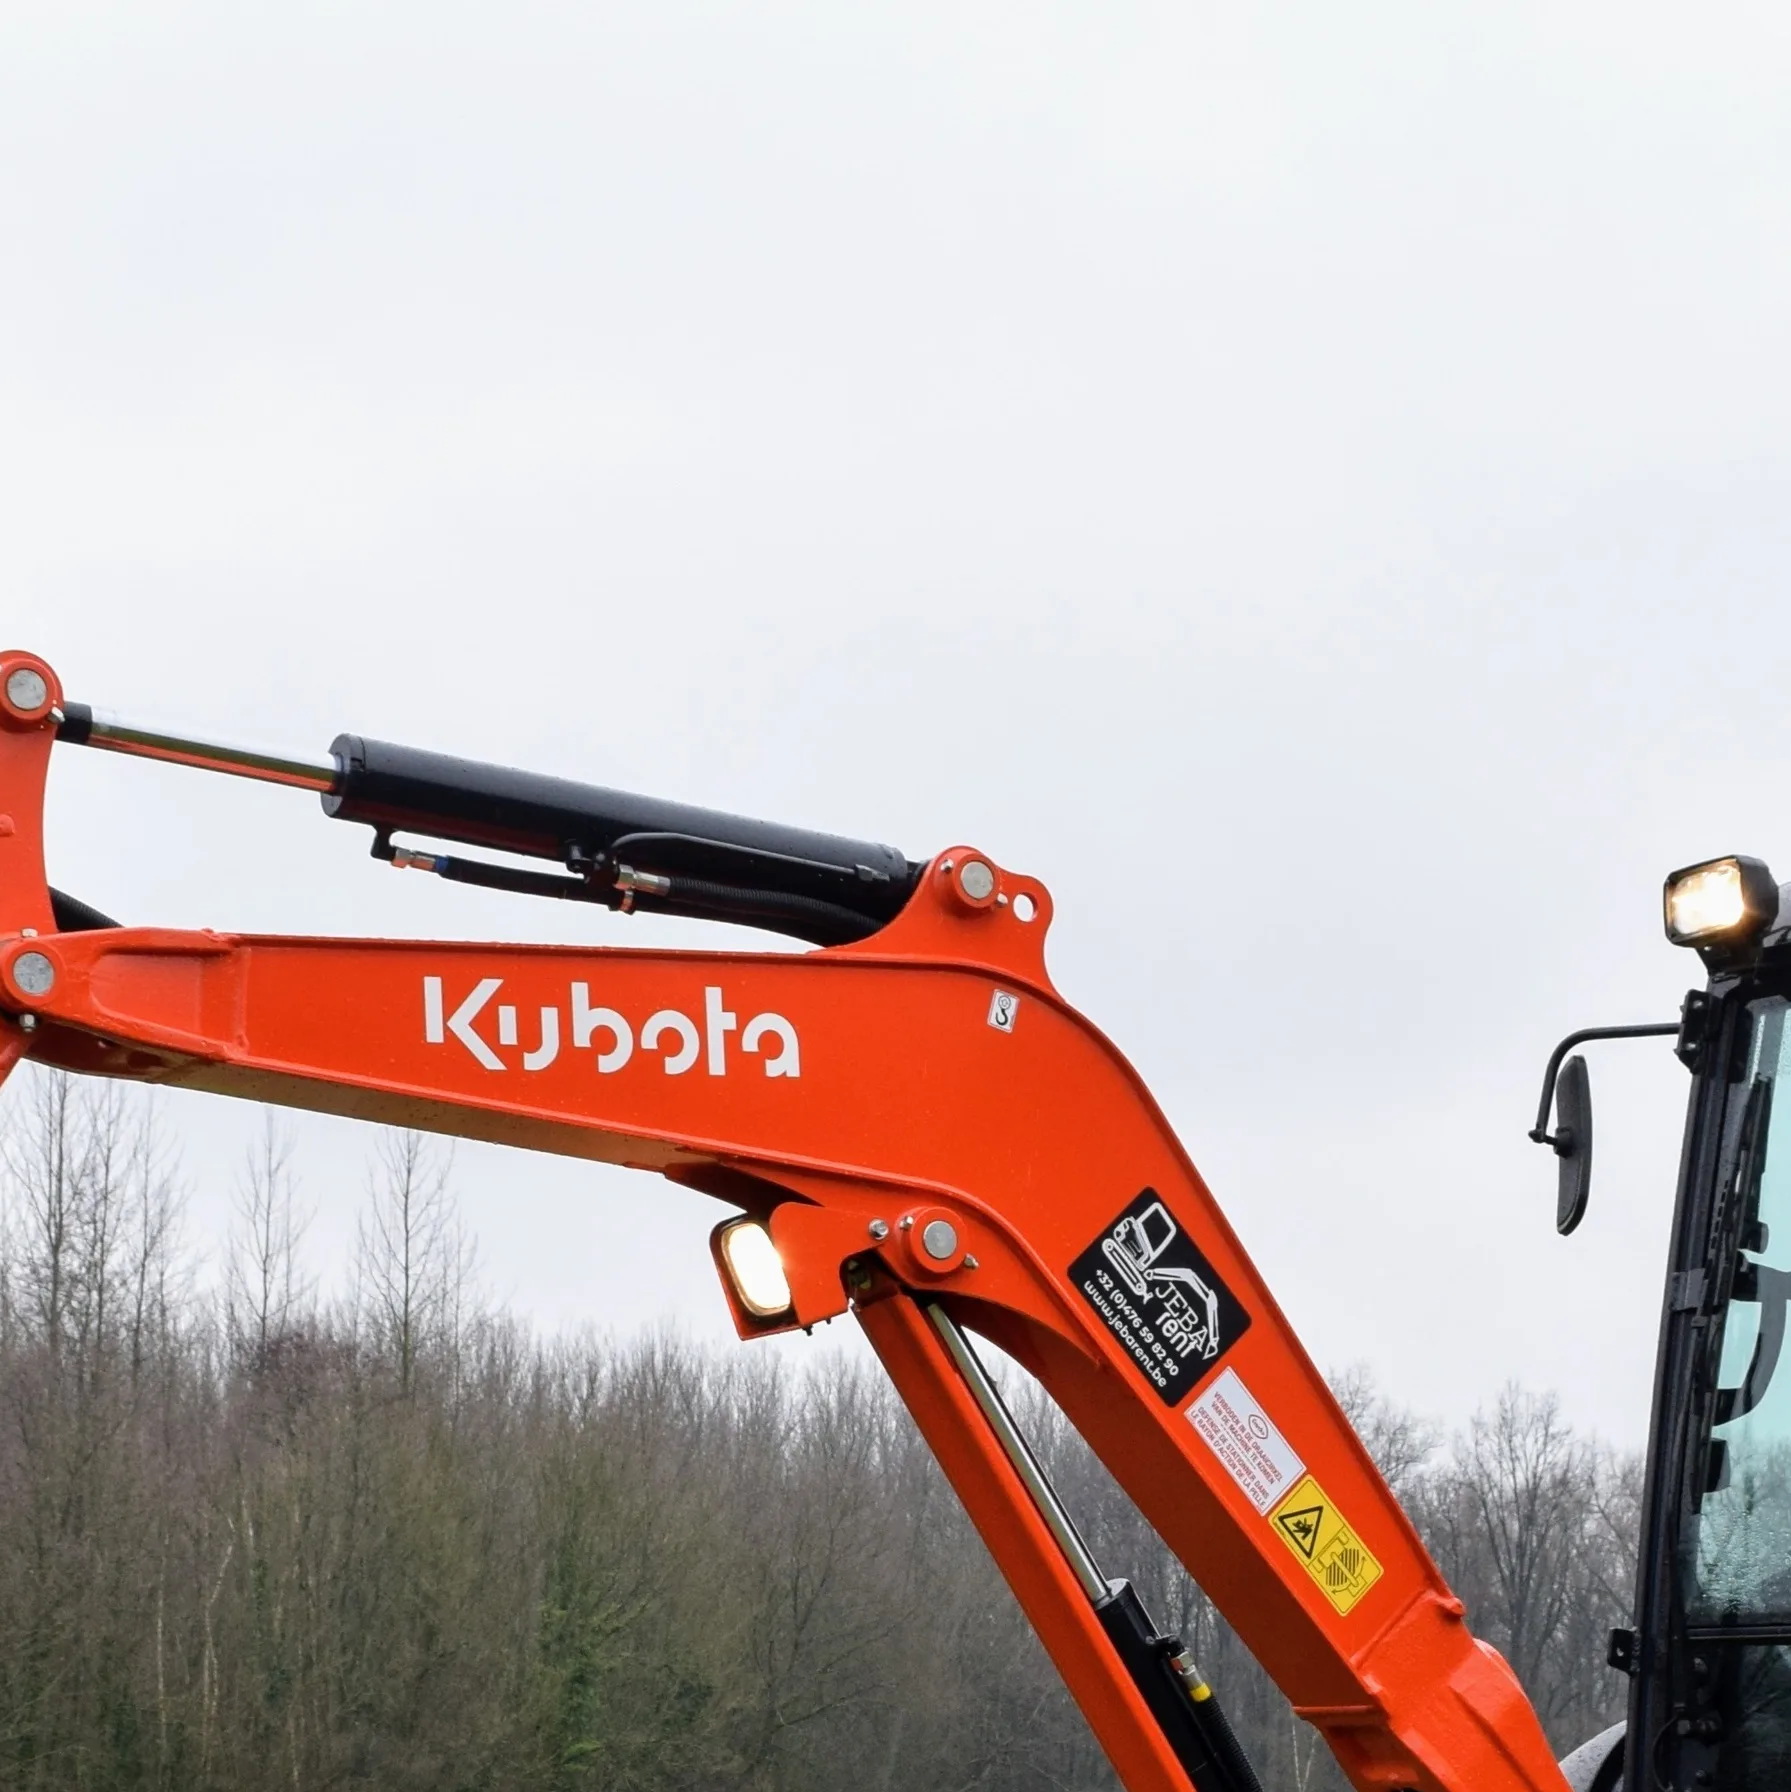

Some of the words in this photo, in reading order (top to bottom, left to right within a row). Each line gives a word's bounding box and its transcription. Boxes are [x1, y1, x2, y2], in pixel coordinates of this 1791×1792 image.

[424, 976, 800, 1077] Kubota
[1085, 1281, 1166, 1386] www.jebarent.be
[1097, 1270, 1113, 1291] +32
[1110, 1290, 1142, 1327] (0)476
[1139, 1327, 1153, 1343] 59
[1152, 1343, 1166, 1360] 82
[1164, 1358, 1178, 1375] 90
[1155, 1282, 1209, 1352] JEBA
[1156, 1312, 1195, 1357] rent
